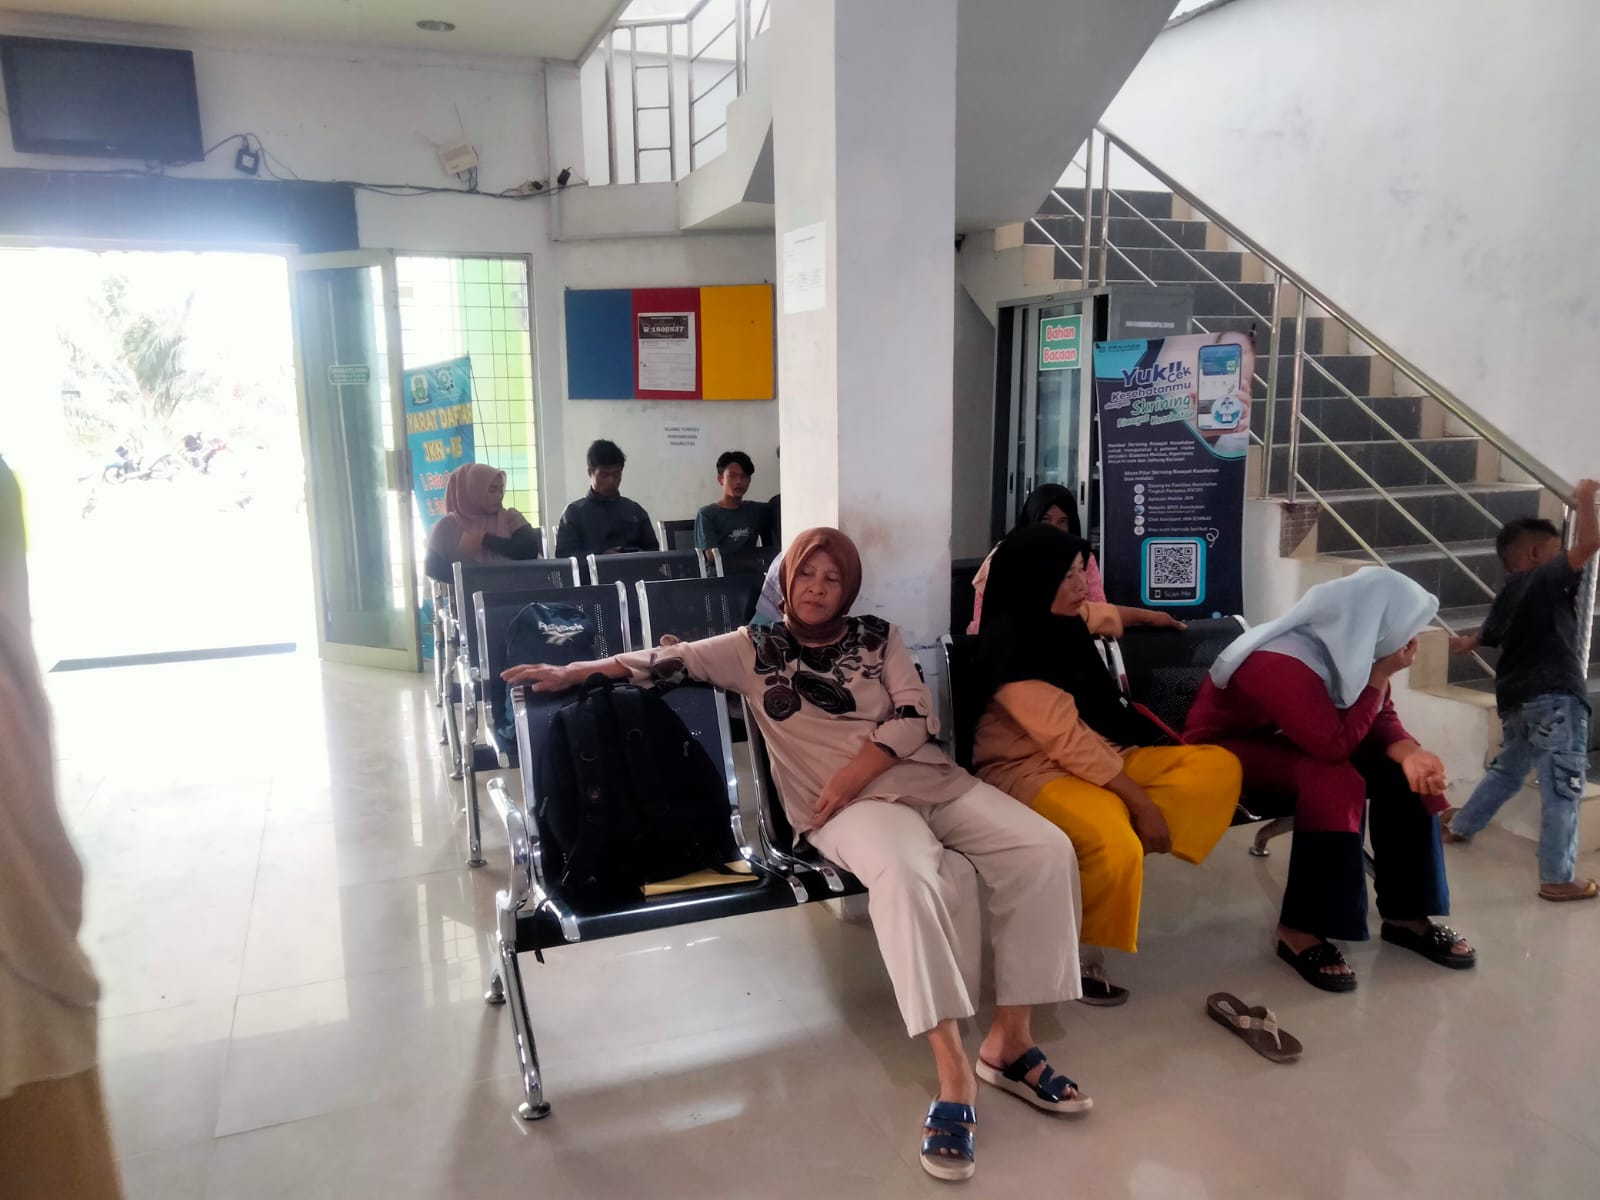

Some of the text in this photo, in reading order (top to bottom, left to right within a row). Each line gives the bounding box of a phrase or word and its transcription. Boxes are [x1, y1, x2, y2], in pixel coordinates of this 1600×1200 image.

[1046, 325, 1076, 341] Bahan
[1044, 348, 1077, 362] Bacaan
[1168, 367, 1192, 383] Cek
[1111, 382, 1192, 403] Kesehatanmu
[1131, 395, 1191, 416] Skrining
[407, 409, 438, 433] YARAT
